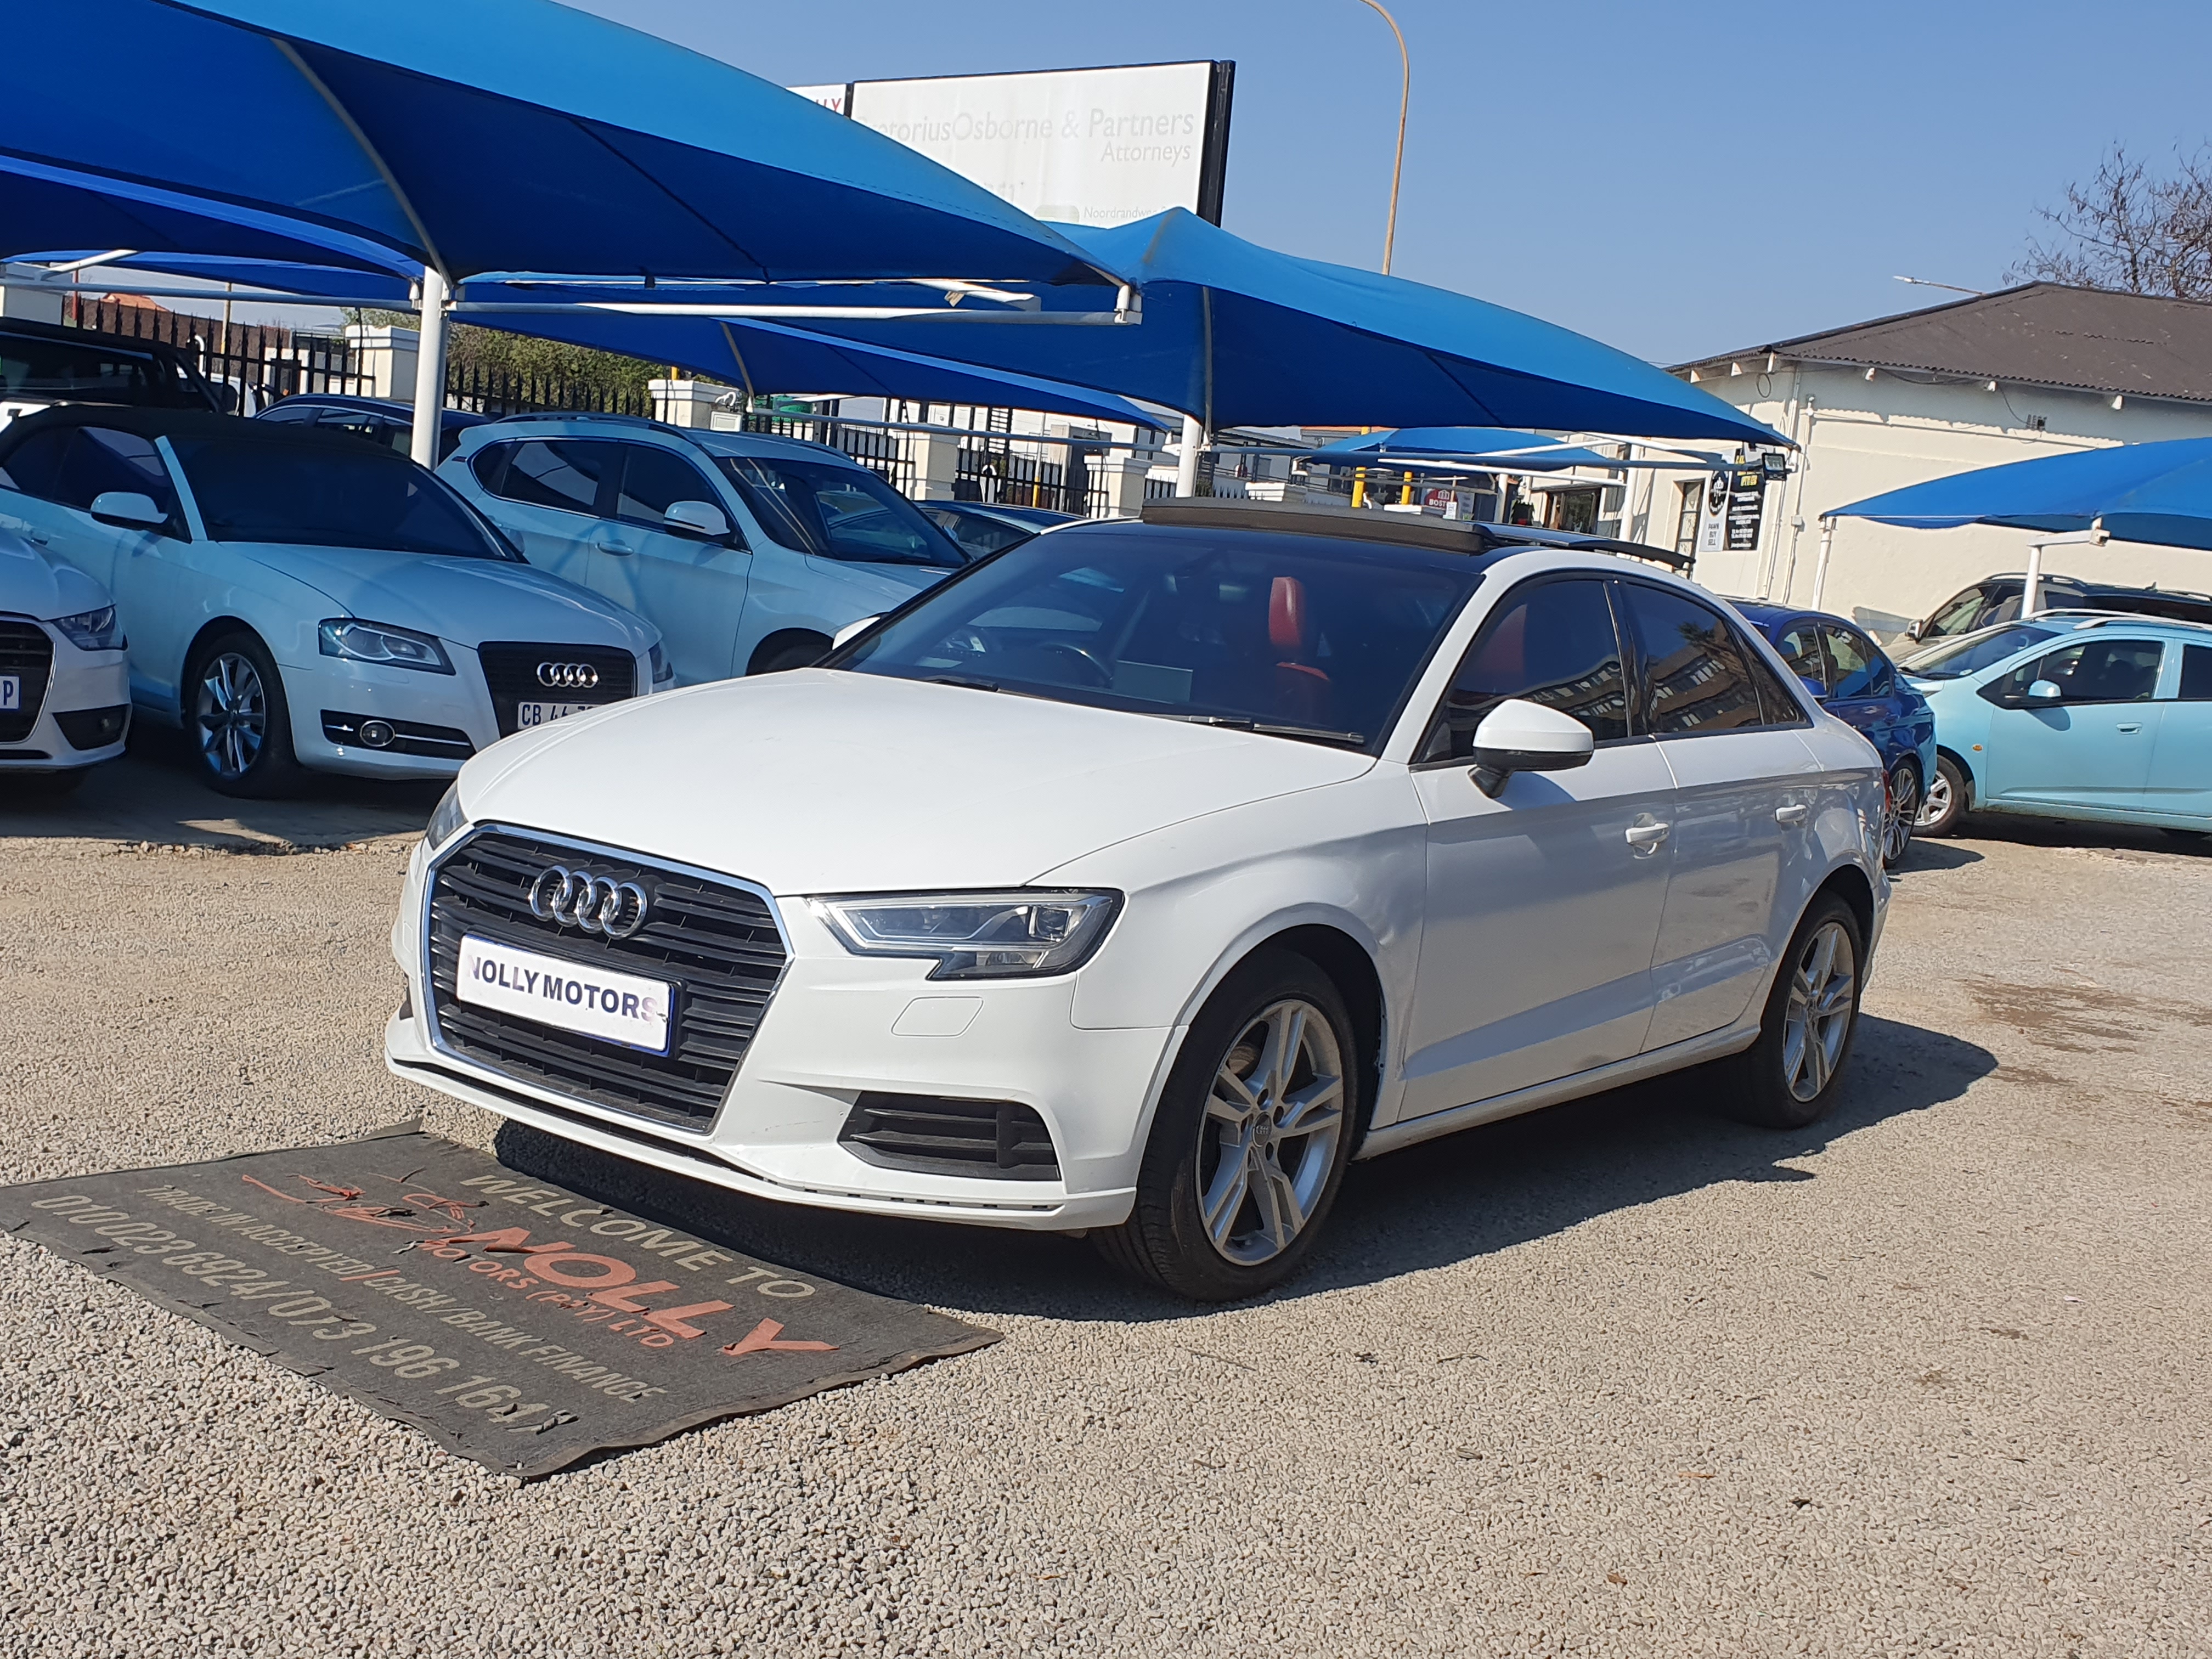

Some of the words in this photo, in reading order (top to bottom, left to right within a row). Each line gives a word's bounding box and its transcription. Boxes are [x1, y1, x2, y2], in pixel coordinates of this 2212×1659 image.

[1060, 109, 1080, 139] &
[1088, 108, 1195, 138] Partners
[1101, 140, 1192, 167] Attorneys
[1429, 498, 1447, 507] BOST
[522, 704, 541, 725] CB
[468, 955, 539, 995] NOLLY
[542, 974, 658, 1023] MOTORS
[460, 1175, 733, 1271] WELCOME
[725, 1266, 816, 1297] TO
[31, 1195, 130, 1224] 010
[94, 1222, 196, 1255] 023
[351, 1338, 460, 1379] 196
[137, 1184, 231, 1216] TRADE
[205, 1212, 258, 1226] IN
[518, 1344, 668, 1403] FINANCE
[438, 1226, 840, 1356] NOLLY
[608, 1319, 674, 1348] LTD
